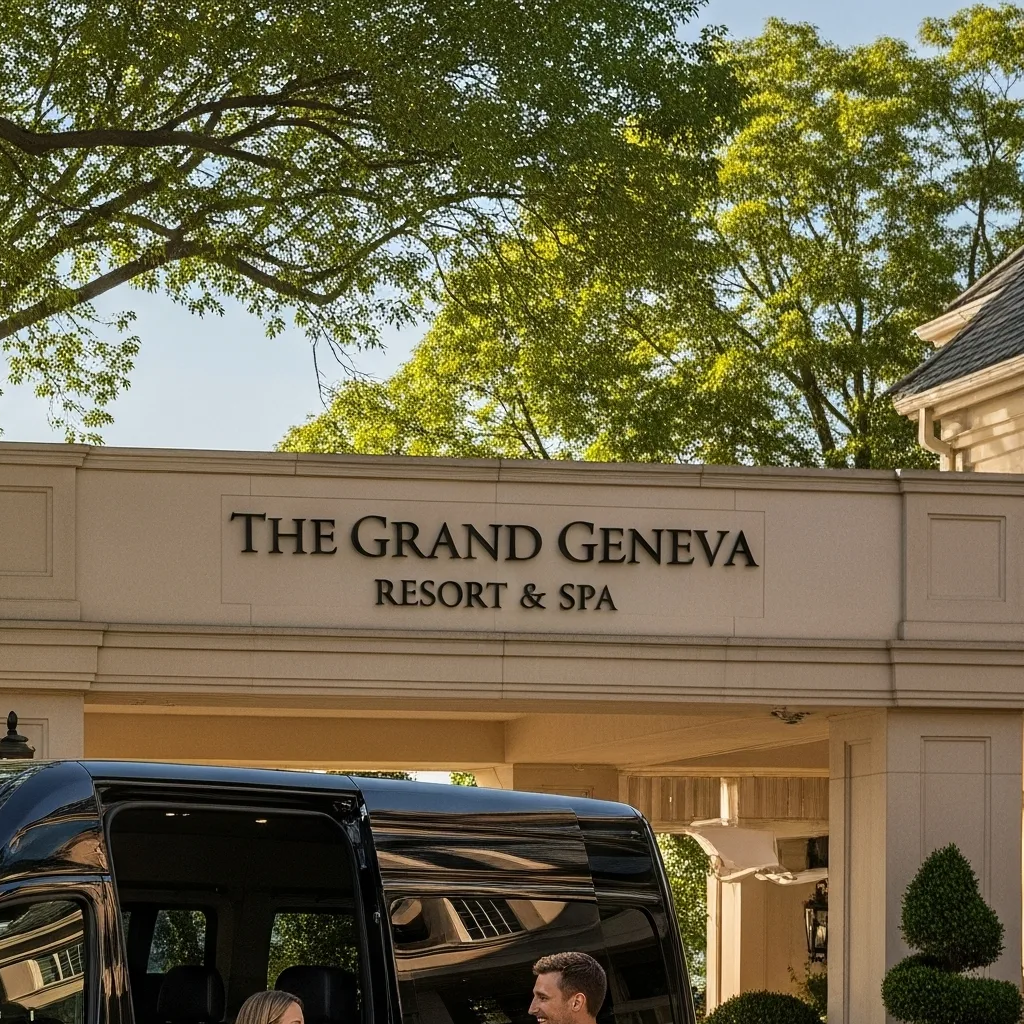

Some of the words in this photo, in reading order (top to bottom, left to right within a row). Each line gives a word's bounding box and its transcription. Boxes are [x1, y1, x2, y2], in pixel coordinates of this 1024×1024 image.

[230, 512, 338, 556] THE
[350, 515, 543, 562] GRAND
[557, 520, 760, 568] GENEVA
[374, 578, 508, 609] RESORT
[519, 582, 547, 610] &
[558, 583, 618, 611] SPA
